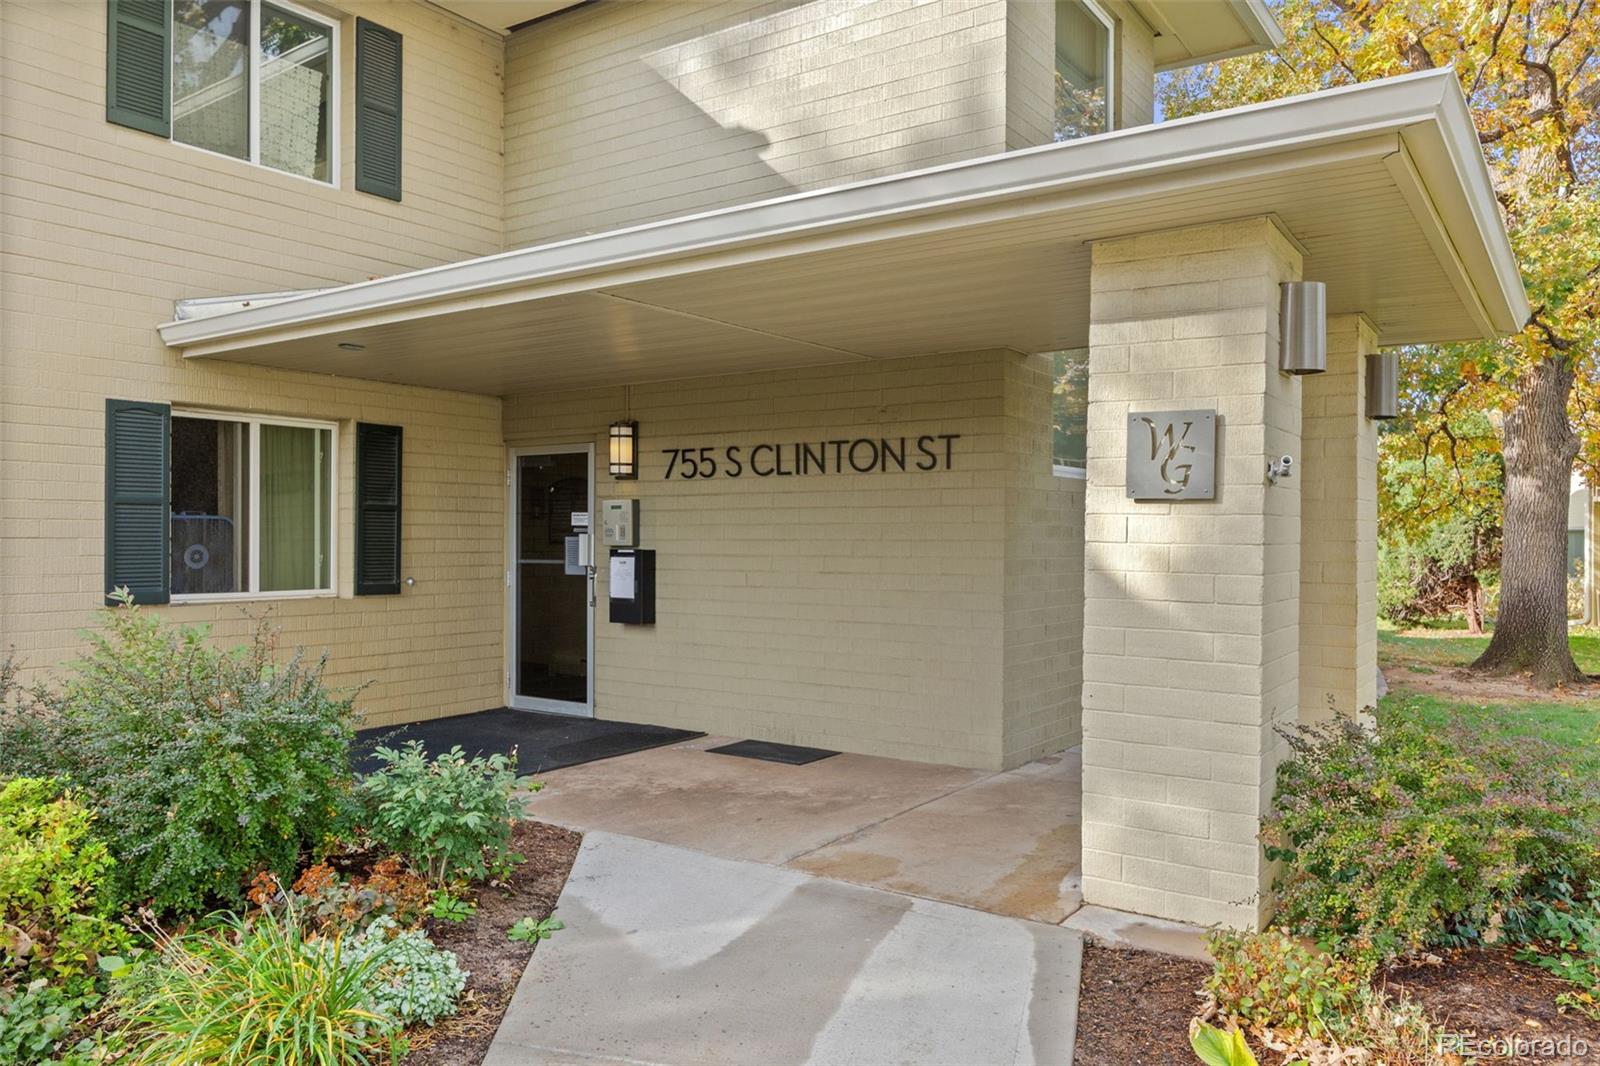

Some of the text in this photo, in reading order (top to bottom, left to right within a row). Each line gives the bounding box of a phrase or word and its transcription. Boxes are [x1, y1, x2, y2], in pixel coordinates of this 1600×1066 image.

[662, 434, 961, 479] 755 S CLINTON ST
